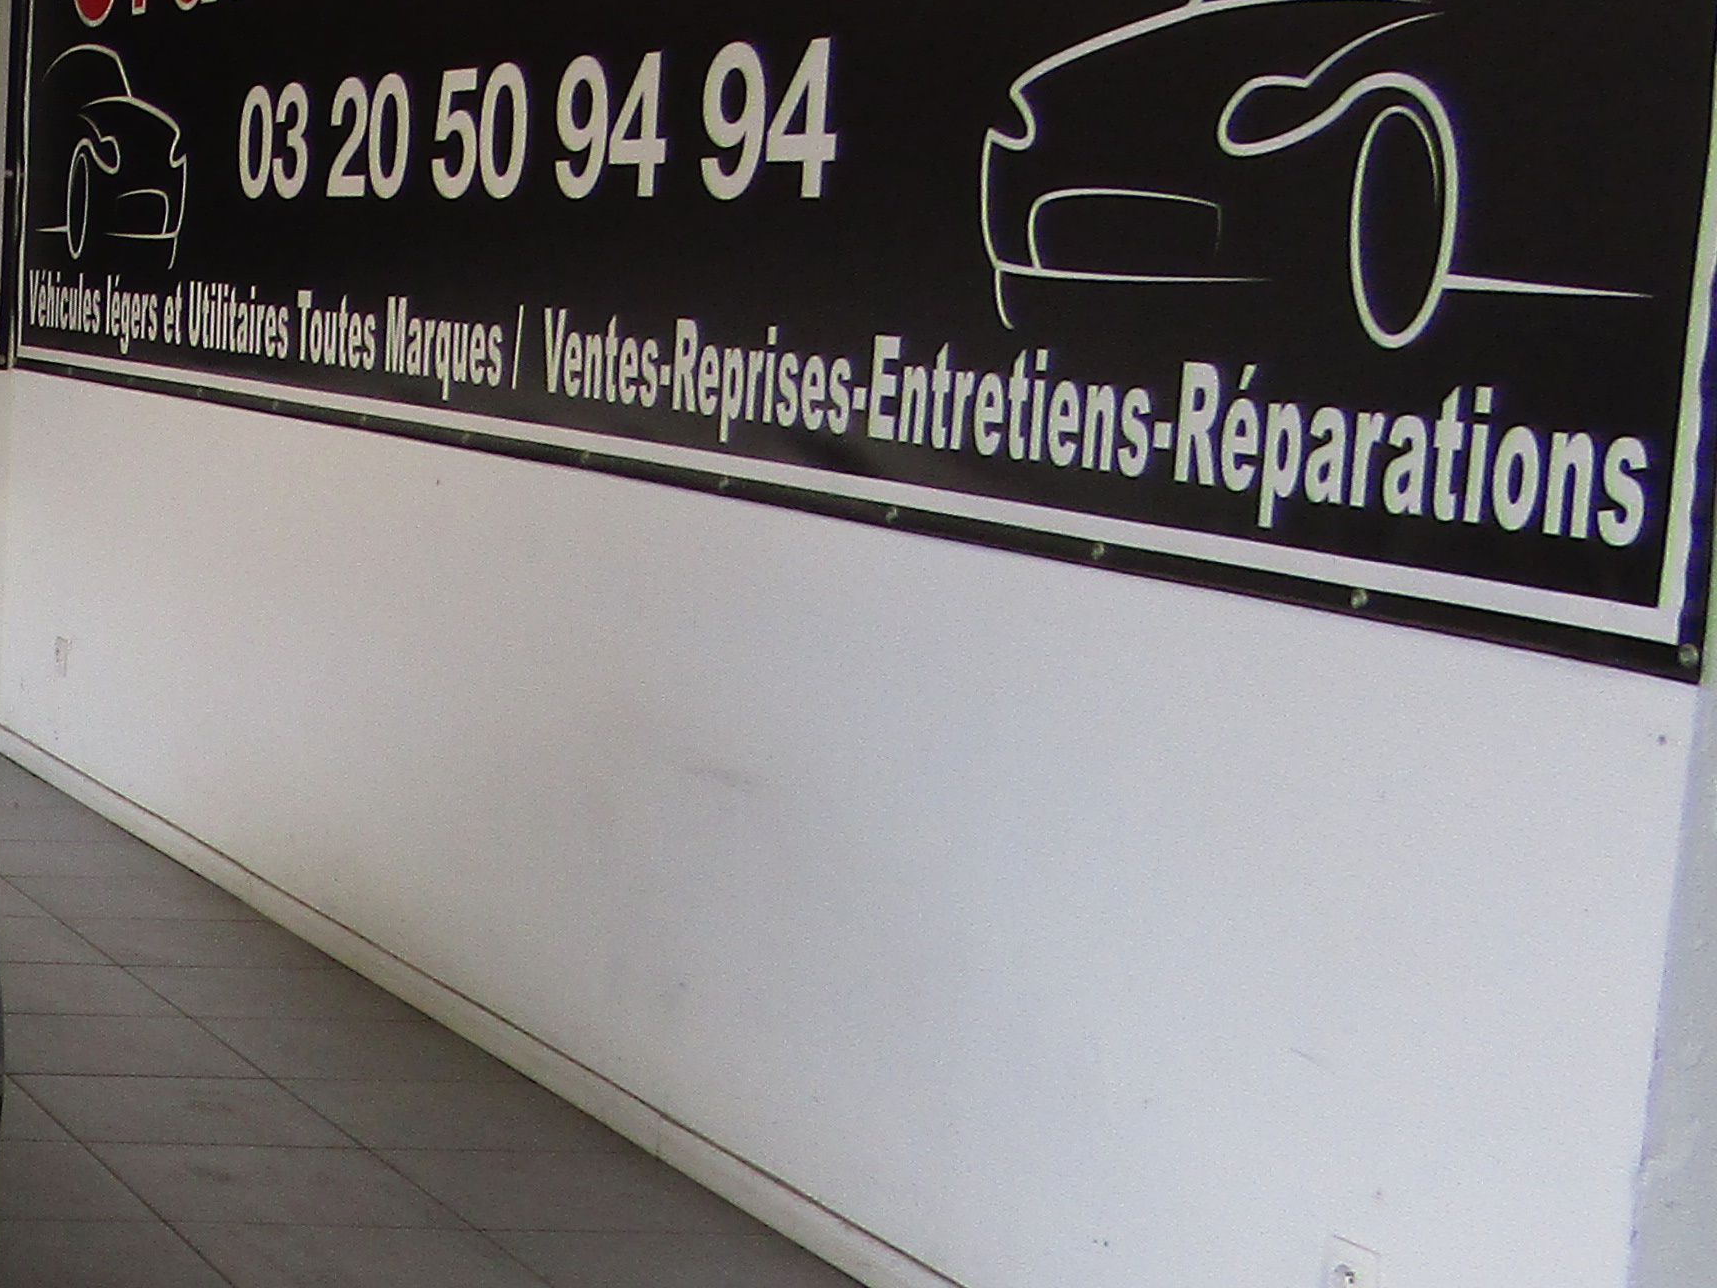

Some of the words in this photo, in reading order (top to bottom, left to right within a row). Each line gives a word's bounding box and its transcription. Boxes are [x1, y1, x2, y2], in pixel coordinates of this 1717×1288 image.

[239, 82, 309, 200] 03
[326, 72, 410, 200] 20
[431, 62, 528, 200] 50
[555, 51, 667, 200] 94
[700, 37, 837, 201] 94
[28, 269, 101, 335] Véhicules
[105, 274, 159, 355] légers
[163, 282, 182, 346] et
[188, 280, 289, 360] Utilitaires
[297, 289, 377, 371] Toutes
[384, 294, 504, 402] Marques
